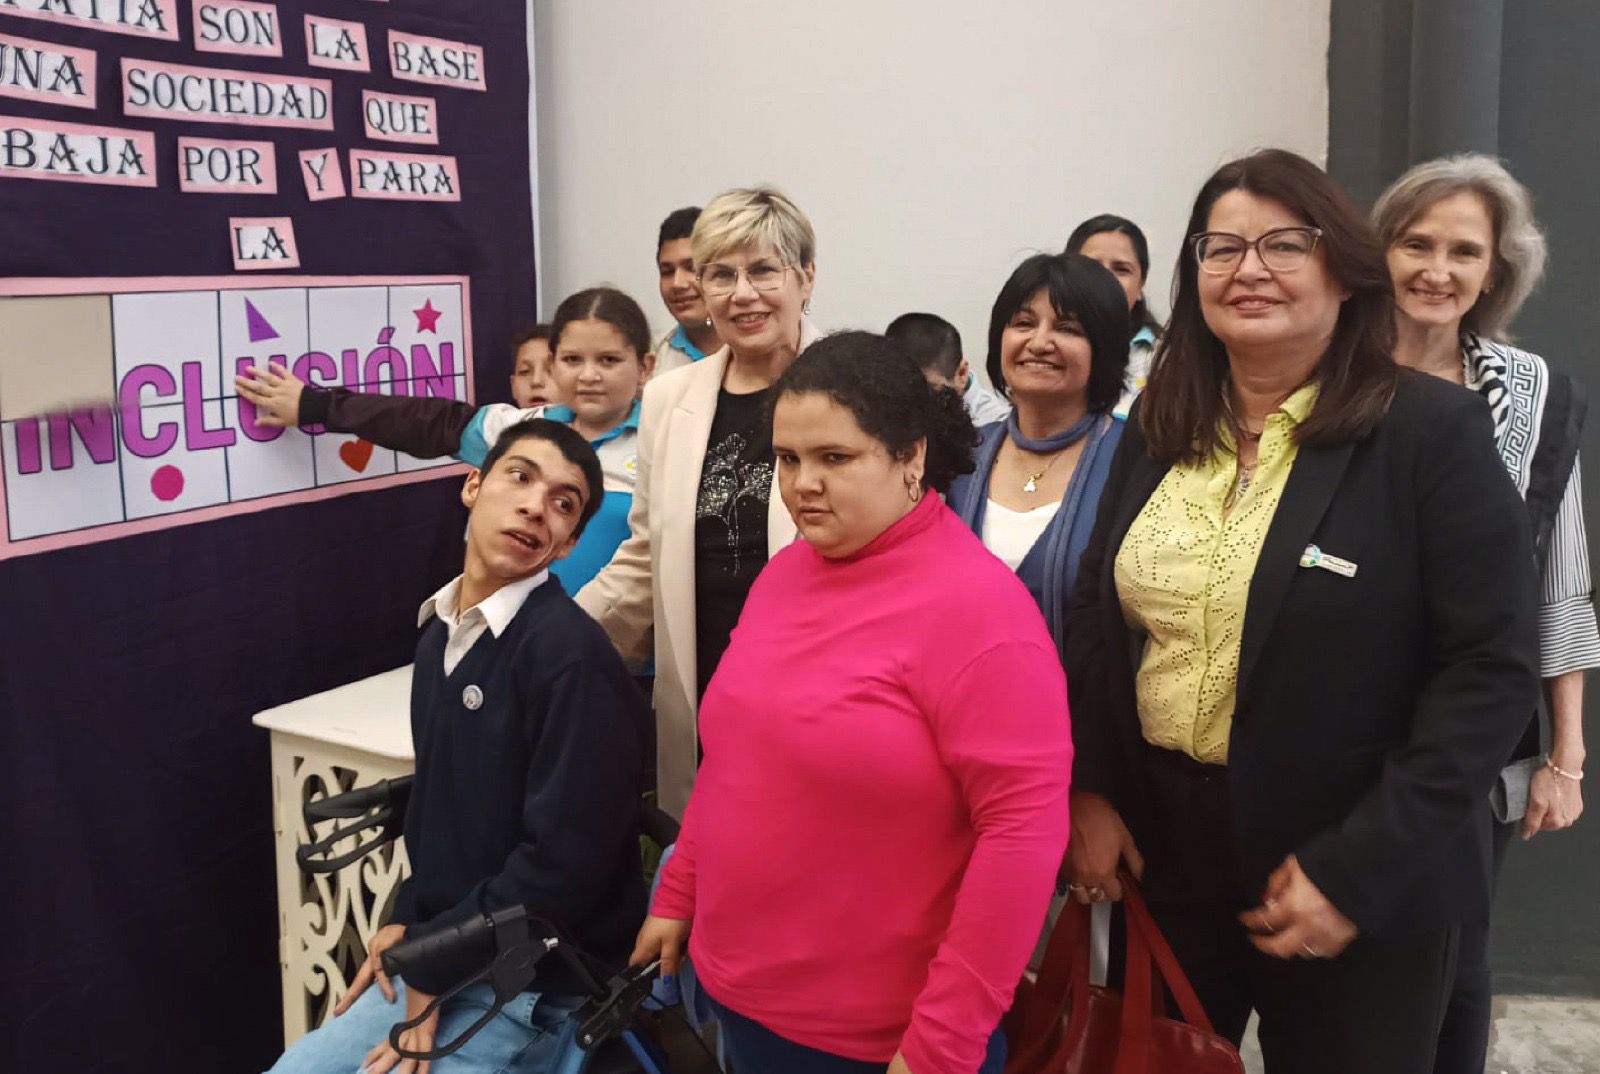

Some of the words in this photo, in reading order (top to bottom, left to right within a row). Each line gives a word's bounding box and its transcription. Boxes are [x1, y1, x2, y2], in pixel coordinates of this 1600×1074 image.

[200, 6, 274, 46] SON
[310, 24, 361, 61] LA
[394, 41, 479, 82] BASE
[0, 44, 85, 95] NA
[127, 68, 328, 120] SOCIEDAD
[366, 98, 431, 135] QUE
[183, 147, 263, 185] POR
[304, 153, 329, 191] Y
[357, 157, 454, 194] PARA
[234, 226, 290, 260] LA
